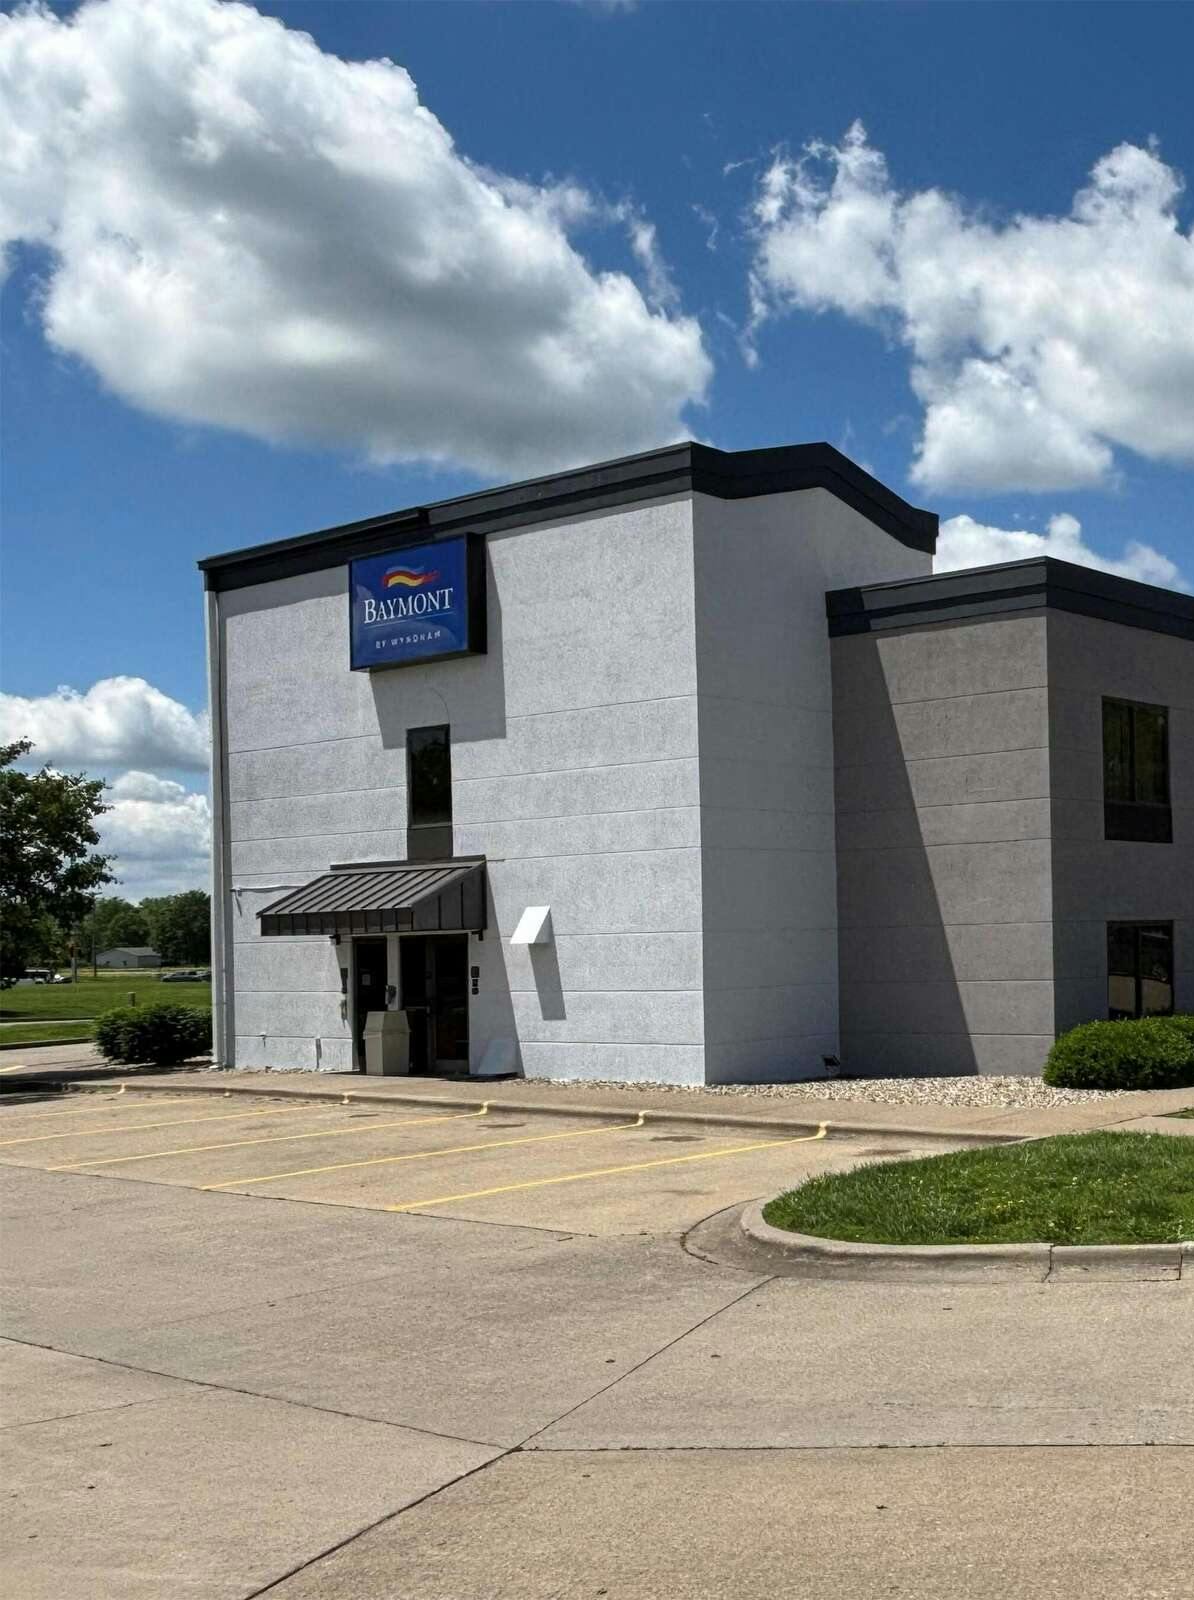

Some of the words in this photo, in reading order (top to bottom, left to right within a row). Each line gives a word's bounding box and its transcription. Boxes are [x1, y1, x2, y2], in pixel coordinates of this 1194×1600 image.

[364, 588, 453, 624] BAYMONT
[375, 640, 386, 649] BY
[391, 630, 441, 646] WYNDHAM
